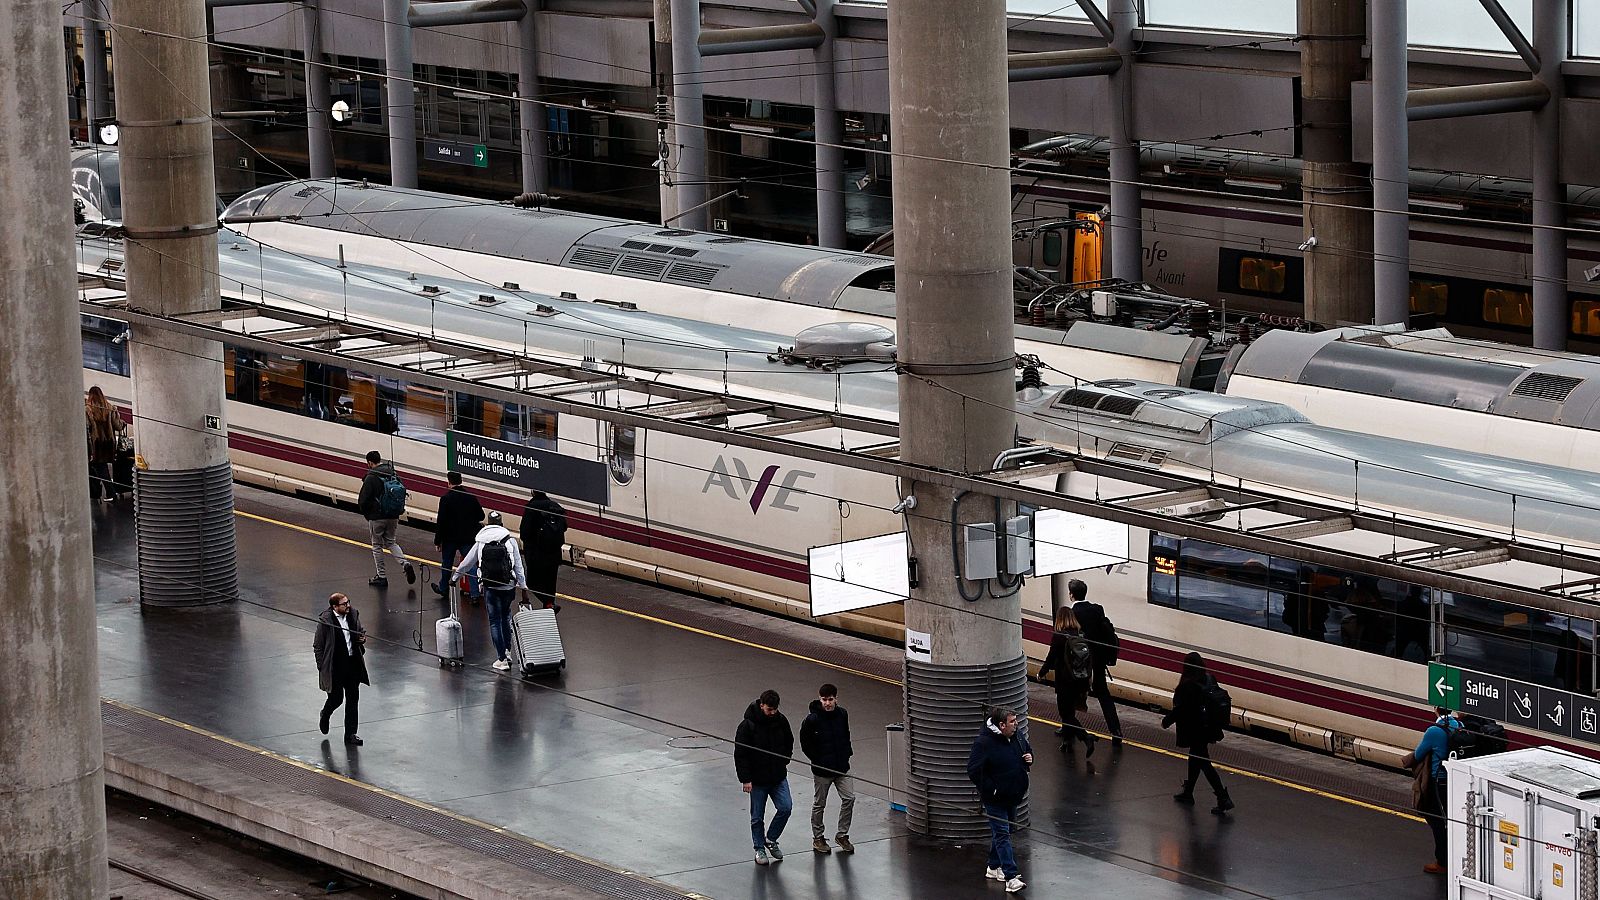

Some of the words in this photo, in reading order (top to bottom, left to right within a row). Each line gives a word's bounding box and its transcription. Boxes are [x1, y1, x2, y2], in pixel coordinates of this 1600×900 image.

[1142, 240, 1168, 267] nfe
[1156, 267, 1186, 286] Avant
[456, 440, 480, 456] Madrid
[481, 446, 504, 462] Puerta
[505, 451, 515, 464] de
[516, 453, 540, 469] Atocha
[457, 454, 491, 472] Almudena
[492, 462, 520, 479] Grandes
[701, 454, 817, 516] AVE
[1466, 679, 1499, 700] Salida
[1465, 697, 1479, 707] EXIT
[1545, 842, 1572, 857] serveo
